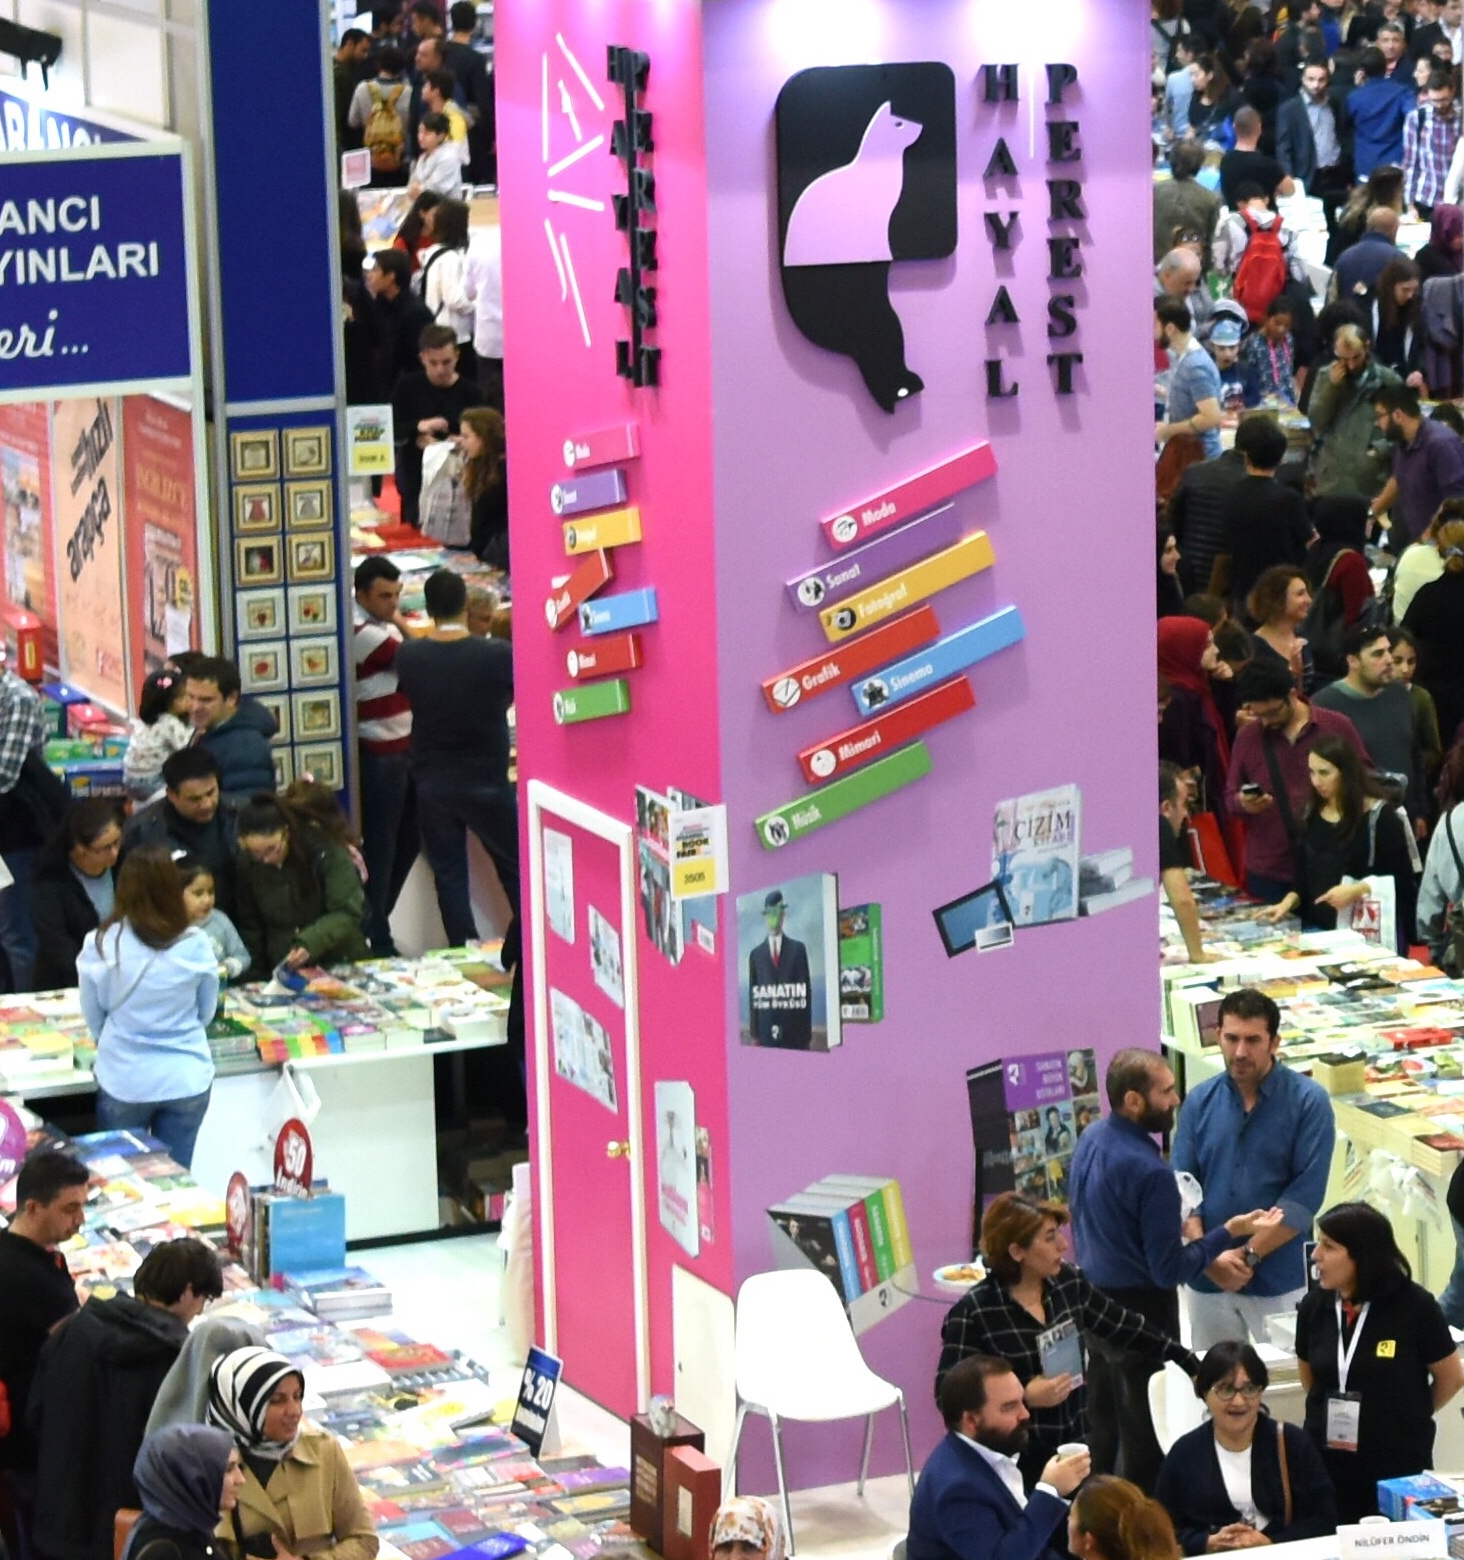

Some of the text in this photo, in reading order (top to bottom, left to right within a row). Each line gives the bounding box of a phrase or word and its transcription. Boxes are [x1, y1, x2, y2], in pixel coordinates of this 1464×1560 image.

[983, 64, 1020, 398] HAYAL
[1045, 64, 1083, 394] PEREST
[861, 501, 896, 527] Moda
[825, 564, 860, 590] Sanat
[802, 661, 840, 690] Grafik
[890, 662, 933, 691] Sinema
[837, 731, 882, 760] Mimari
[1012, 810, 1071, 844] ÇİZİM
[752, 982, 807, 1000] SANATIN
[534, 1375, 553, 1411] 20
[1355, 1534, 1394, 1547] NİLÜFER
